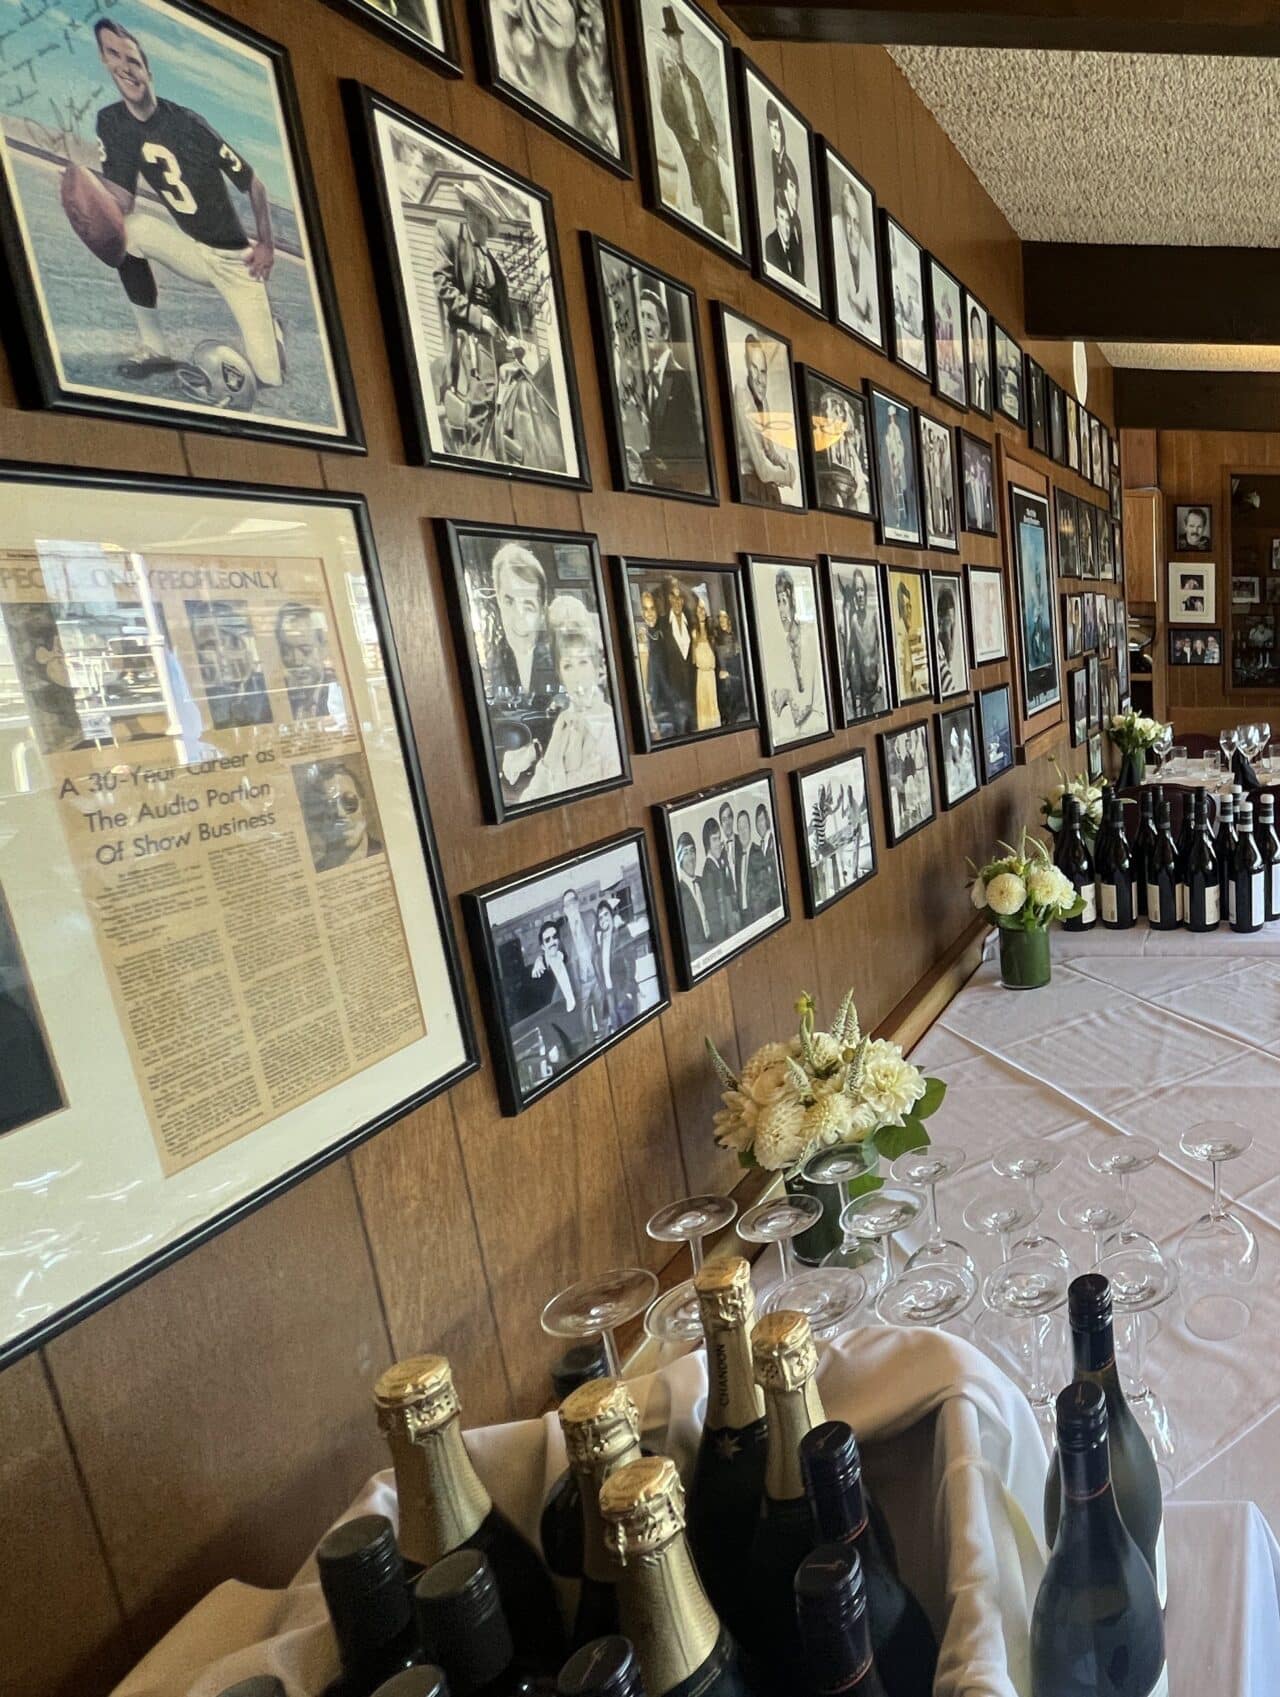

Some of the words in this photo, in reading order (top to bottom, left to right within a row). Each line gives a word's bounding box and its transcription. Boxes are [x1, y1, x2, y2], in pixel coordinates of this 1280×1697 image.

[141, 142, 198, 215] 3
[219, 143, 242, 172] 3
[58, 777, 80, 799] A
[255, 748, 275, 764] as
[84, 809, 127, 833] The
[137, 794, 199, 823] Audio
[206, 783, 271, 808] Portion
[95, 840, 124, 866] Of
[132, 830, 192, 858] Show
[200, 811, 276, 841] Business
[717, 1343, 729, 1407] CHANDON
